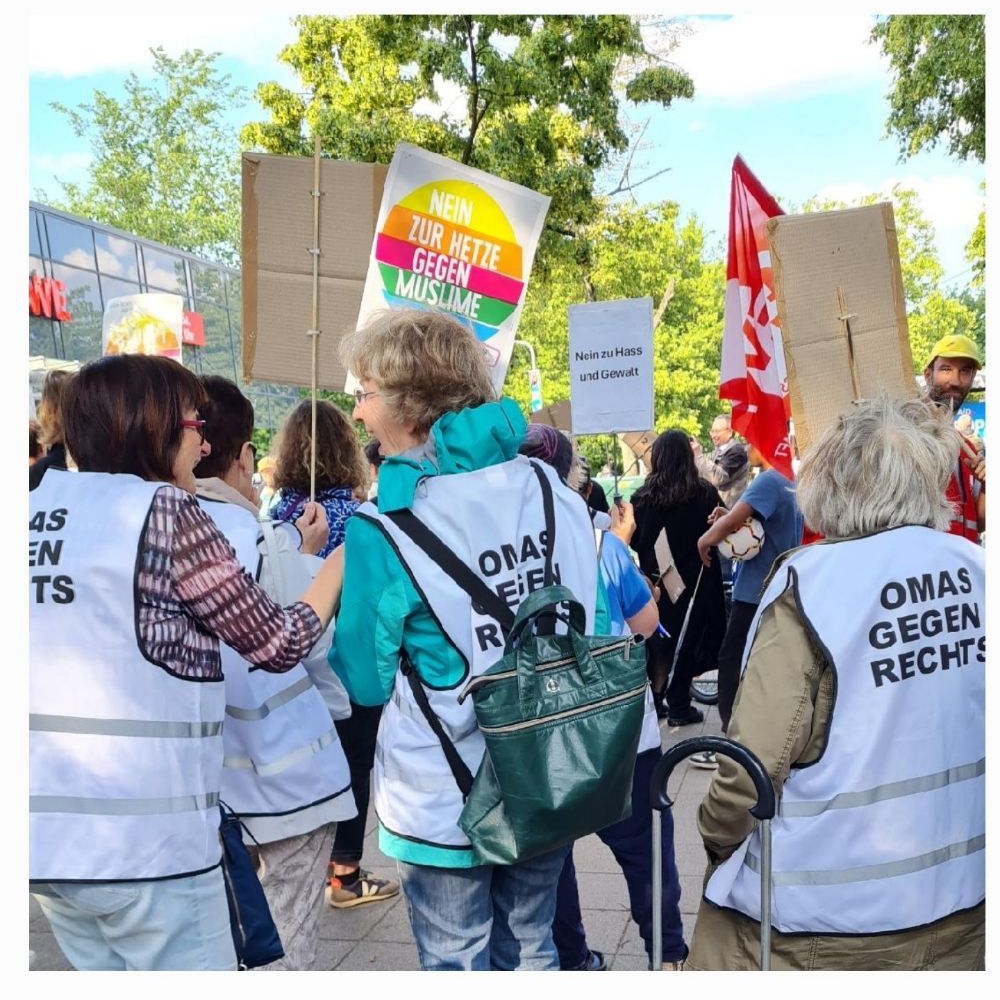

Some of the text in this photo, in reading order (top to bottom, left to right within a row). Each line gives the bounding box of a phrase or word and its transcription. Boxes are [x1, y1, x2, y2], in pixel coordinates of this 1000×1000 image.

[428, 188, 474, 226] NEIN
[408, 215, 501, 270] ZUR HETZE
[412, 247, 472, 288] GEGEN
[394, 268, 483, 318] MUSLIME
[575, 346, 644, 362] Nein zu Hass
[579, 367, 640, 382] und Gewalt
[879, 566, 973, 611] OMAS
[868, 602, 981, 650] GEGEN
[869, 635, 986, 688] RECHTS
